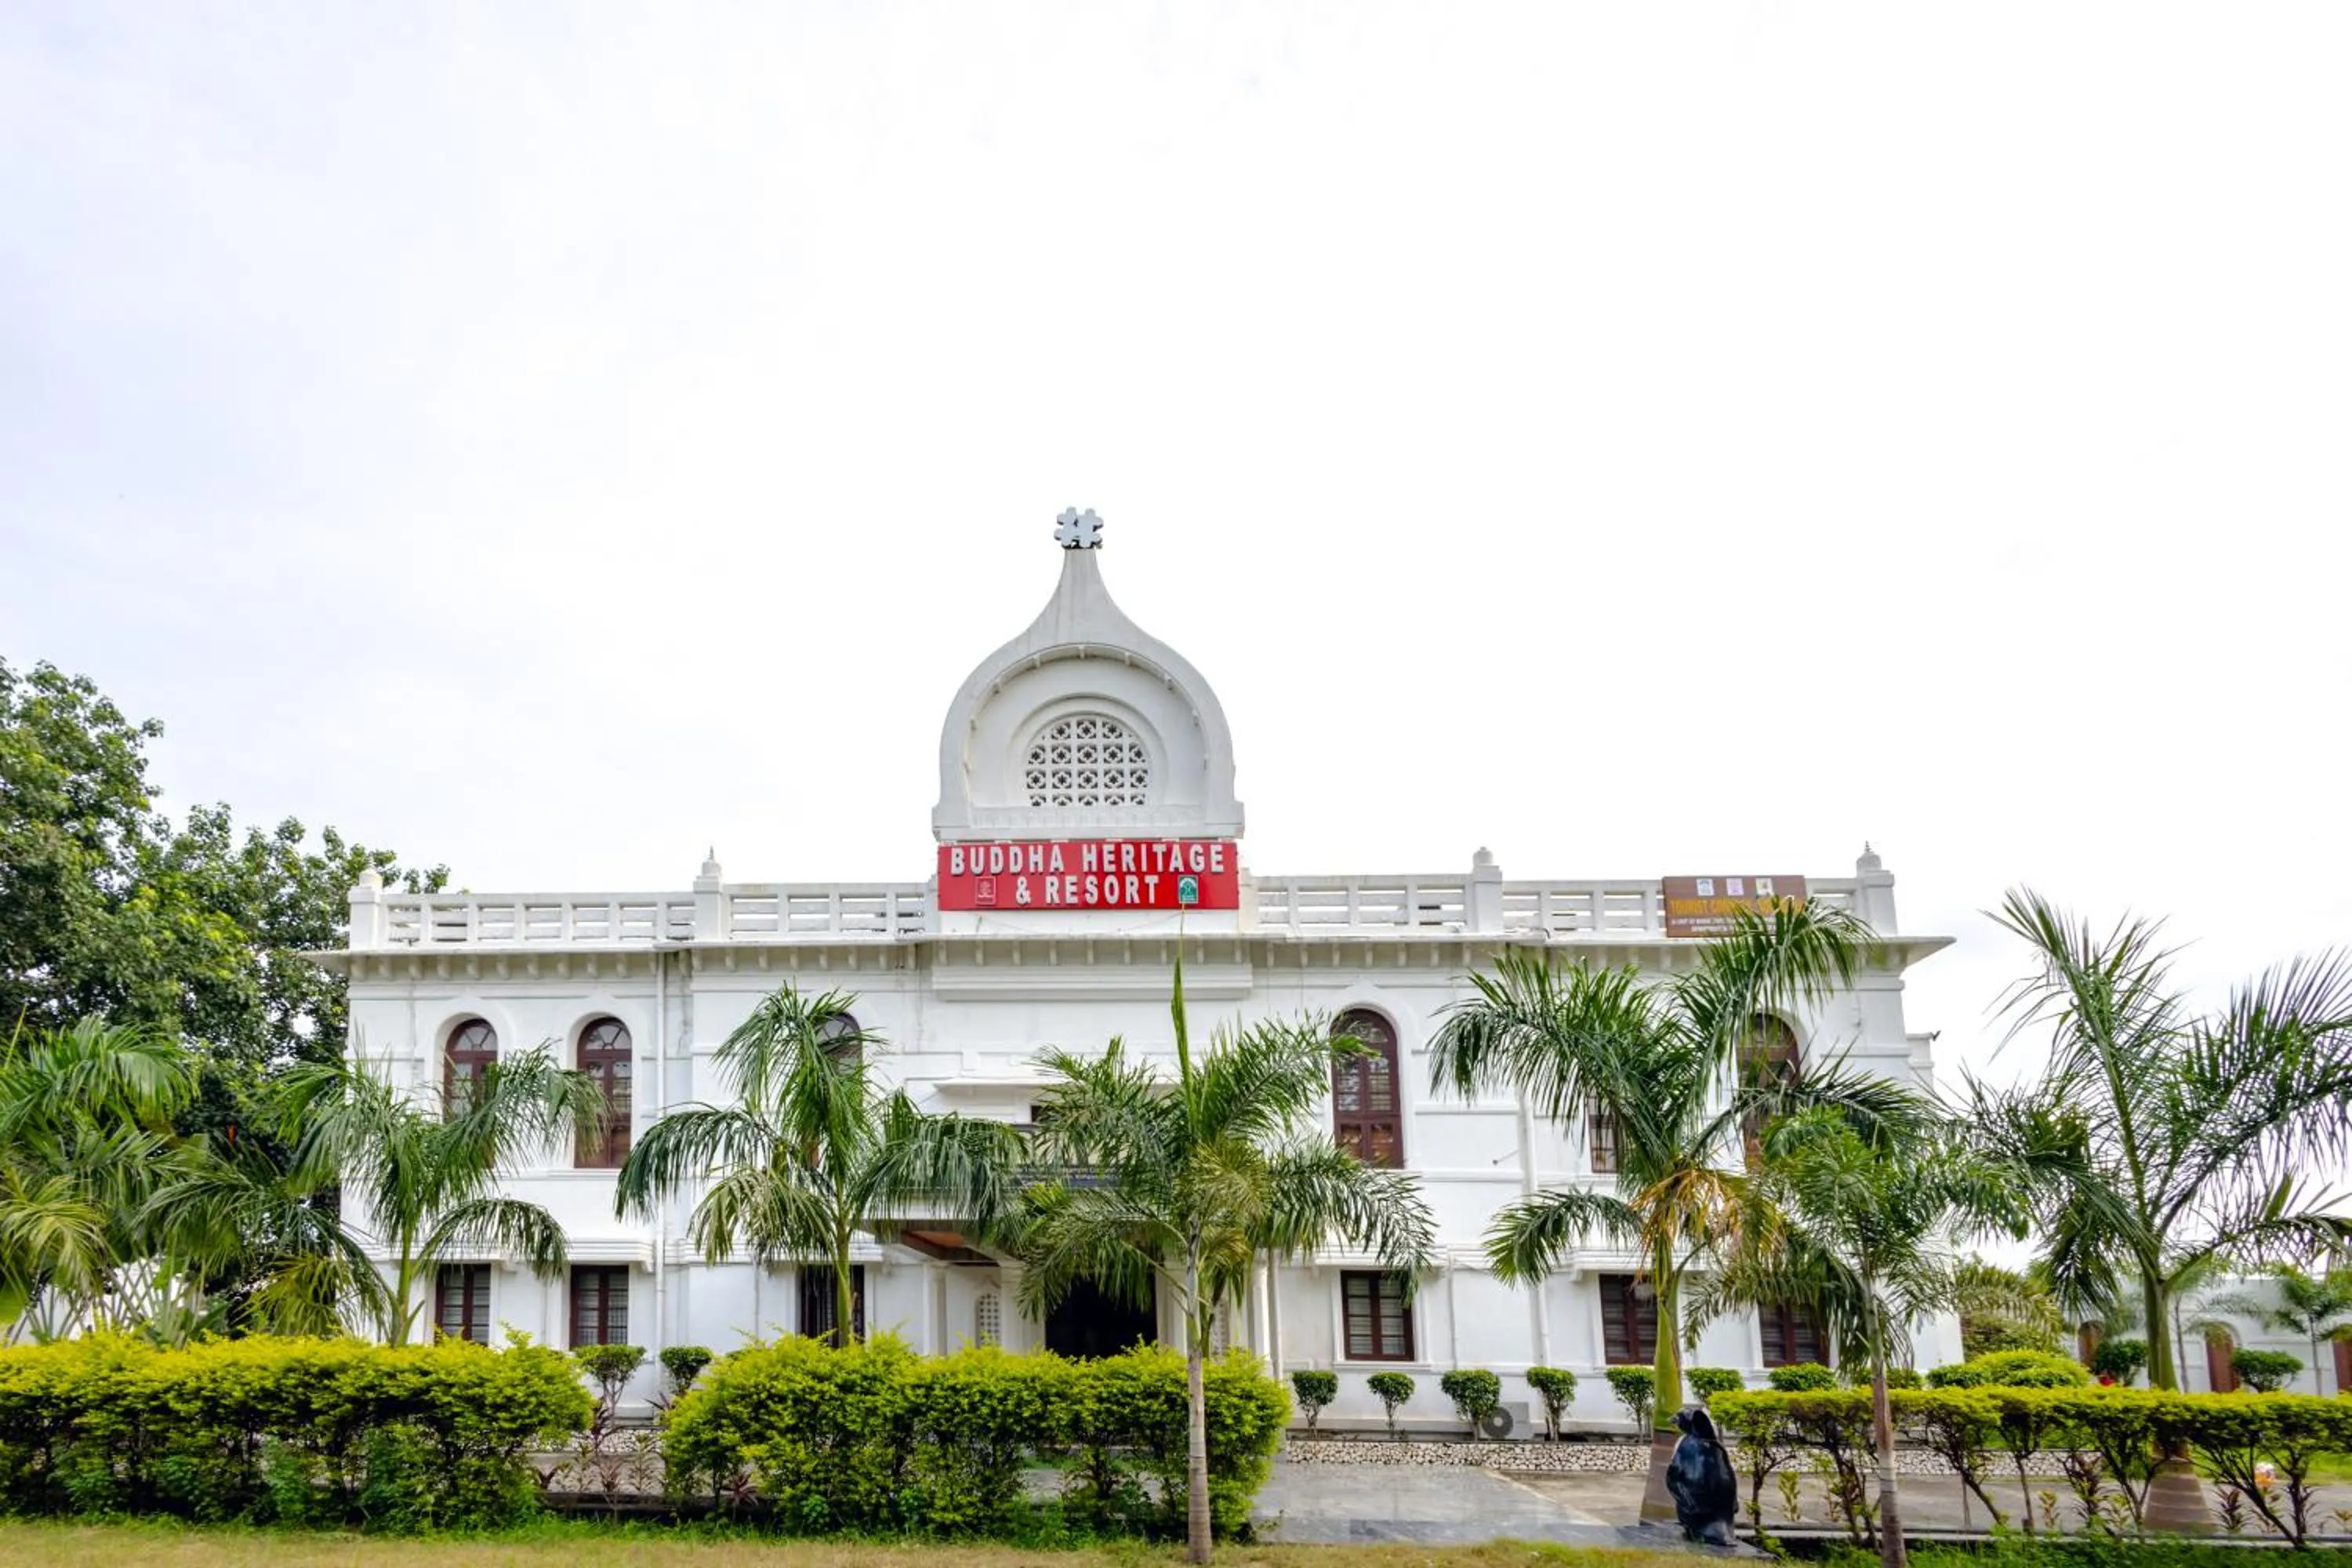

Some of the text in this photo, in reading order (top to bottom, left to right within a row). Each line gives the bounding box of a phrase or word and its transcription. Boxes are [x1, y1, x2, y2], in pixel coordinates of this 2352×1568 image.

[950, 843, 1224, 874] BUDDHA HERITAGE
[1015, 875, 1159, 904] & RESORT
